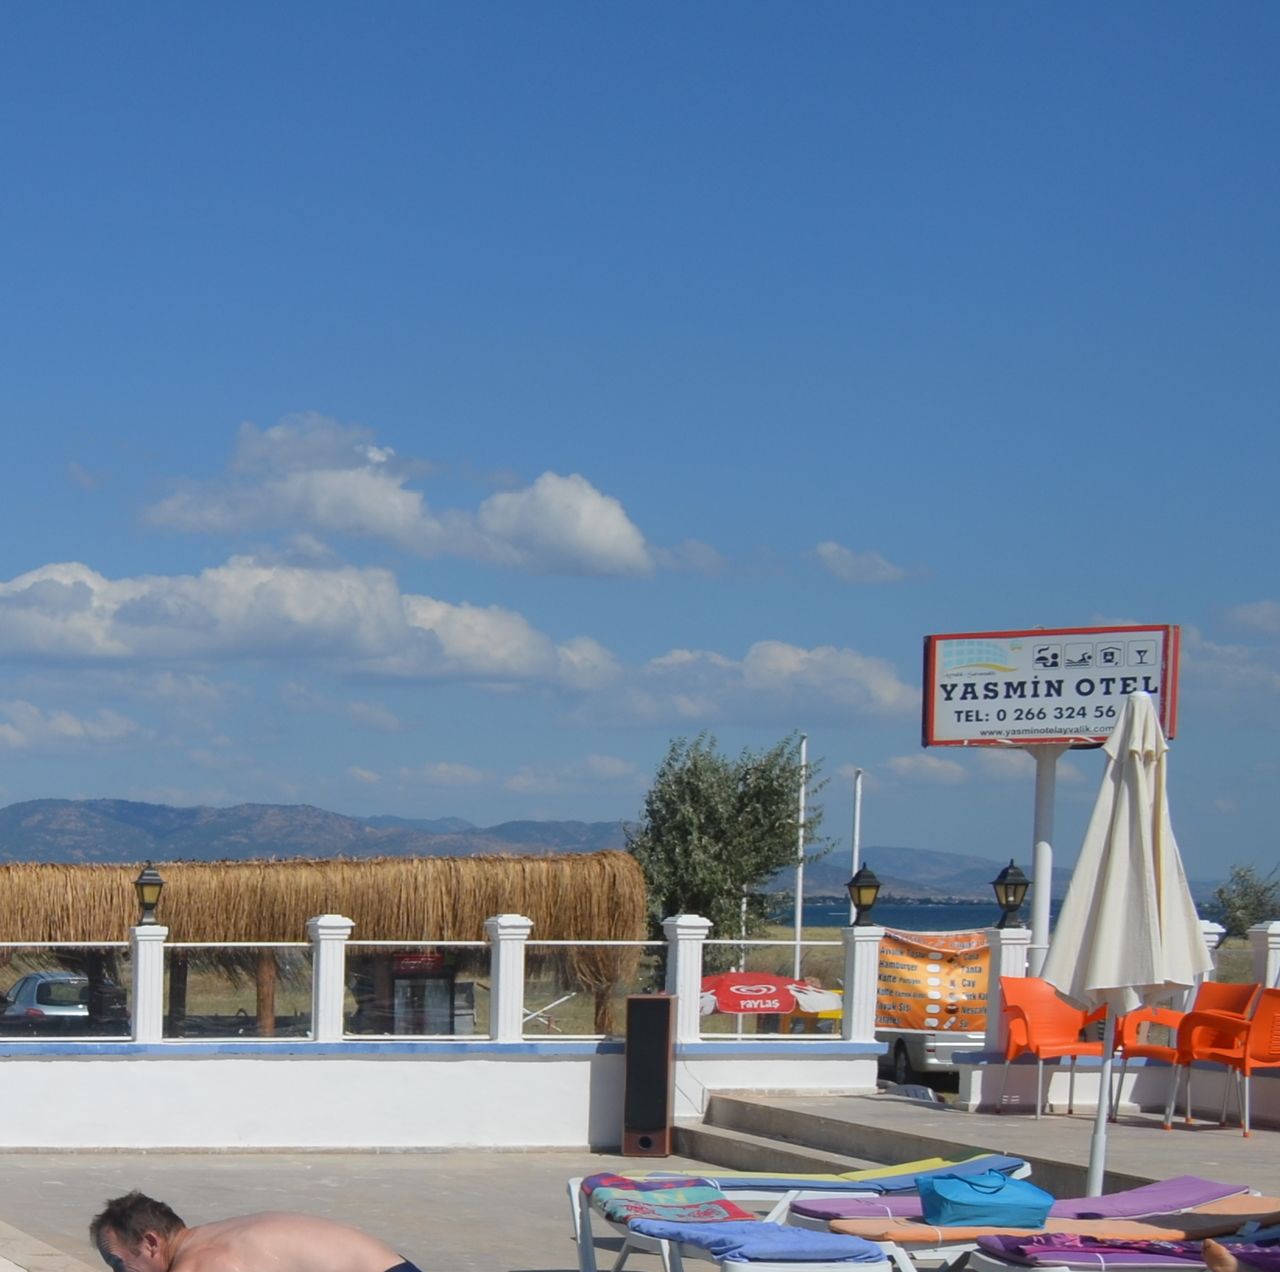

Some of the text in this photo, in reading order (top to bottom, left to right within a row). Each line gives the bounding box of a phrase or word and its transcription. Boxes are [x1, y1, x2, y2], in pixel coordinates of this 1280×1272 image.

[940, 675, 1065, 701] YASMİN
[1075, 676, 1158, 697] OTEL
[954, 705, 1117, 723] TEL: 0 266 324 56
